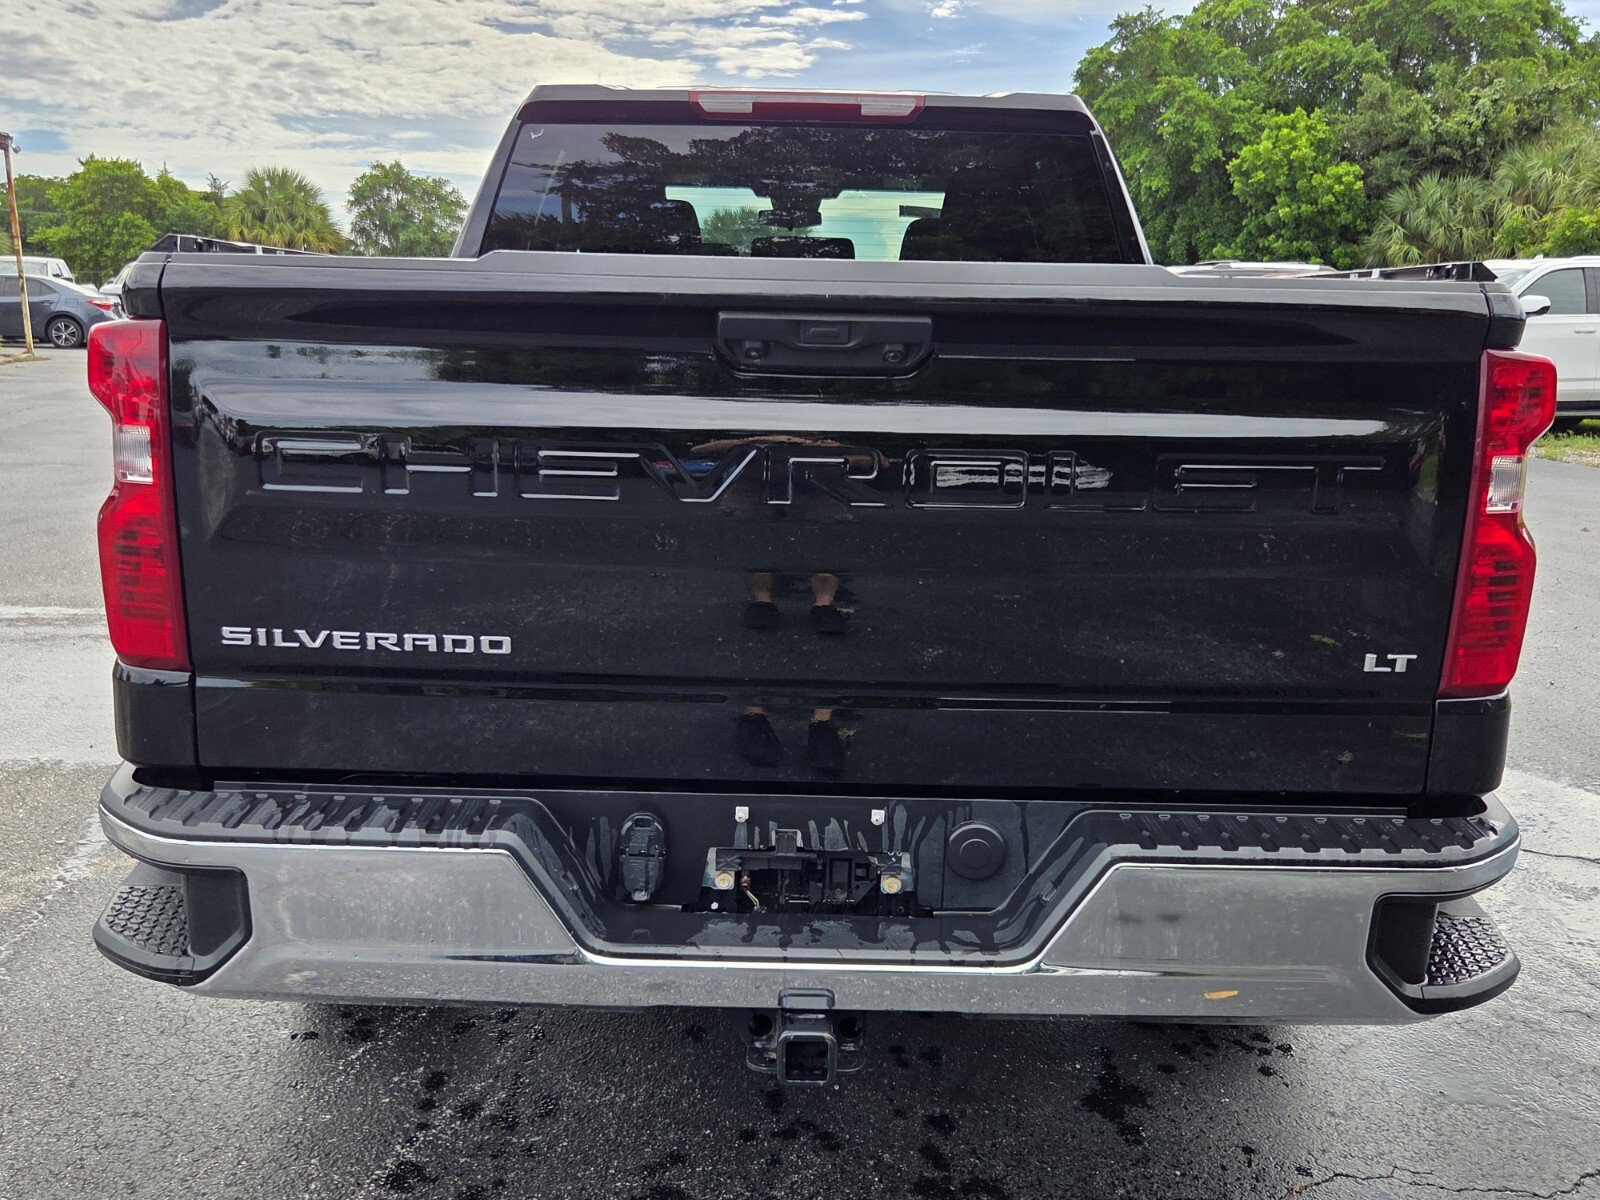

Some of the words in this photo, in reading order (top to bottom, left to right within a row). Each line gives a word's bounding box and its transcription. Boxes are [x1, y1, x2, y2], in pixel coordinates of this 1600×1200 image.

[254, 431, 1386, 515] CHEVROLET
[221, 626, 512, 654] SILVERADO
[1363, 653, 1418, 673] LT
